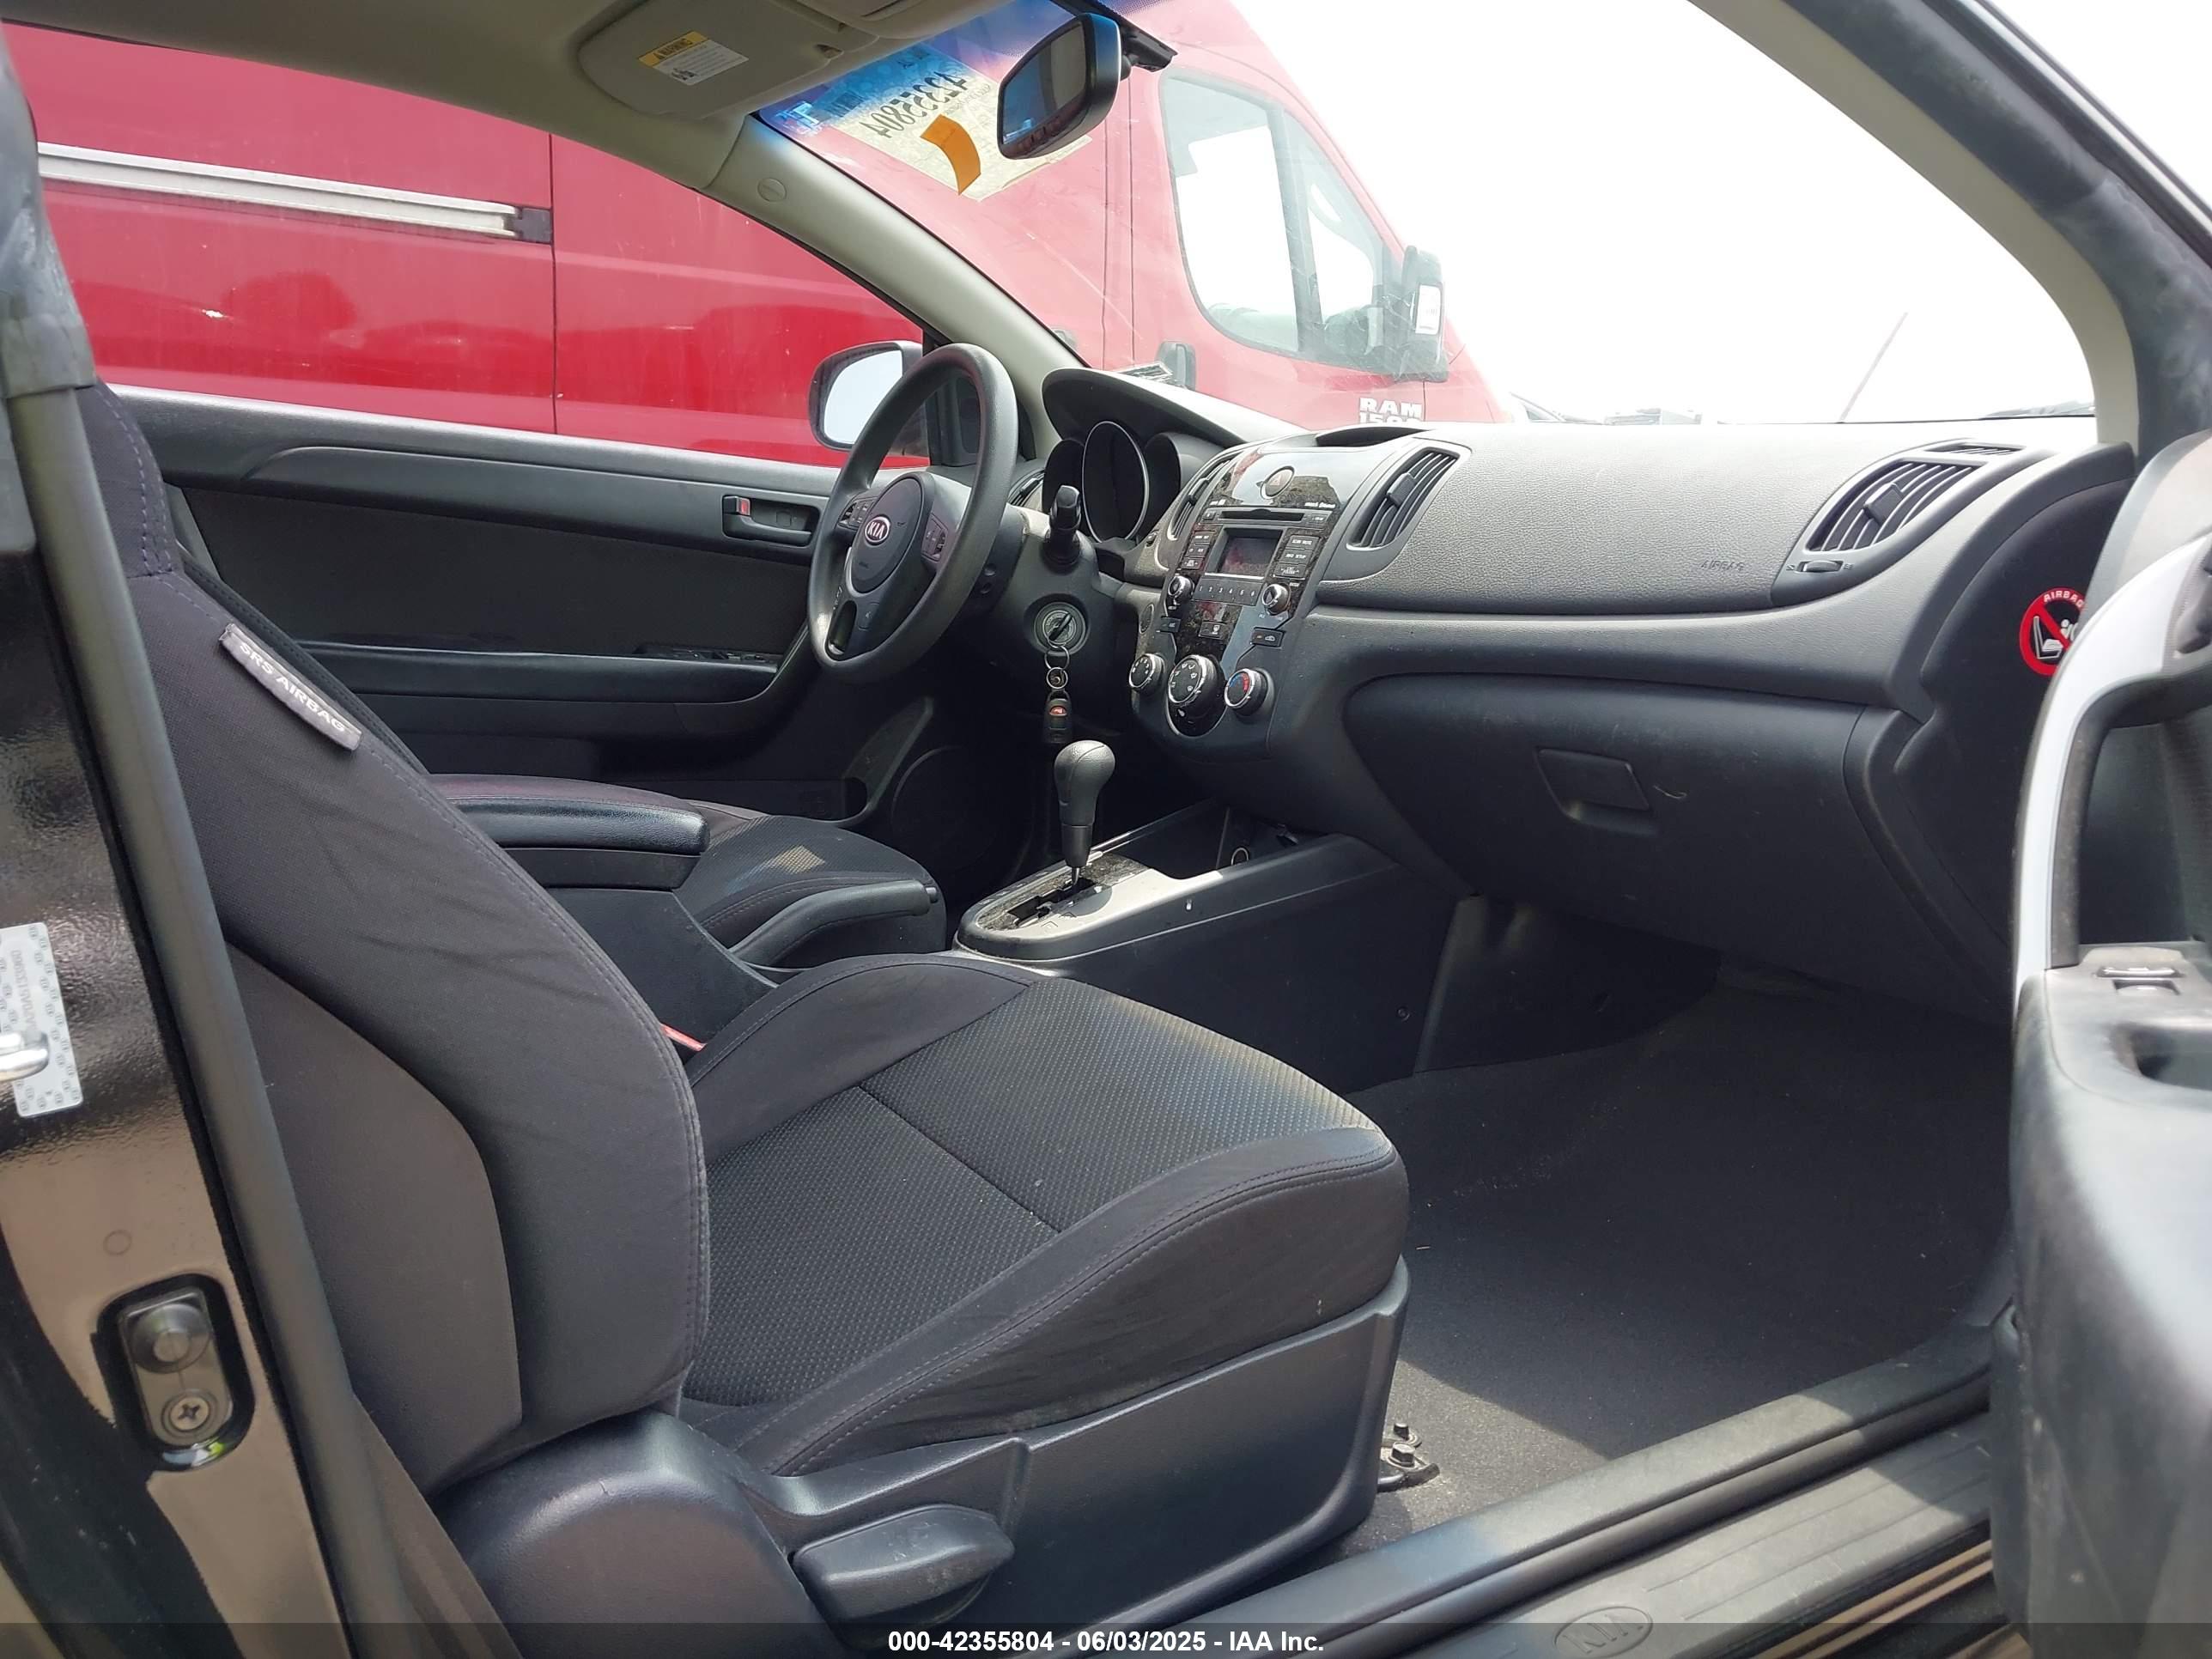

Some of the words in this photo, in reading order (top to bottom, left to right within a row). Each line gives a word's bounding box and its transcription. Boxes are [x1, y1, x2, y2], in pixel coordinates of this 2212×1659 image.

[1359, 397, 1423, 418] RAM
[866, 520, 886, 539] KIA
[240, 641, 274, 674] SRS
[276, 675, 344, 732] AIRBAG
